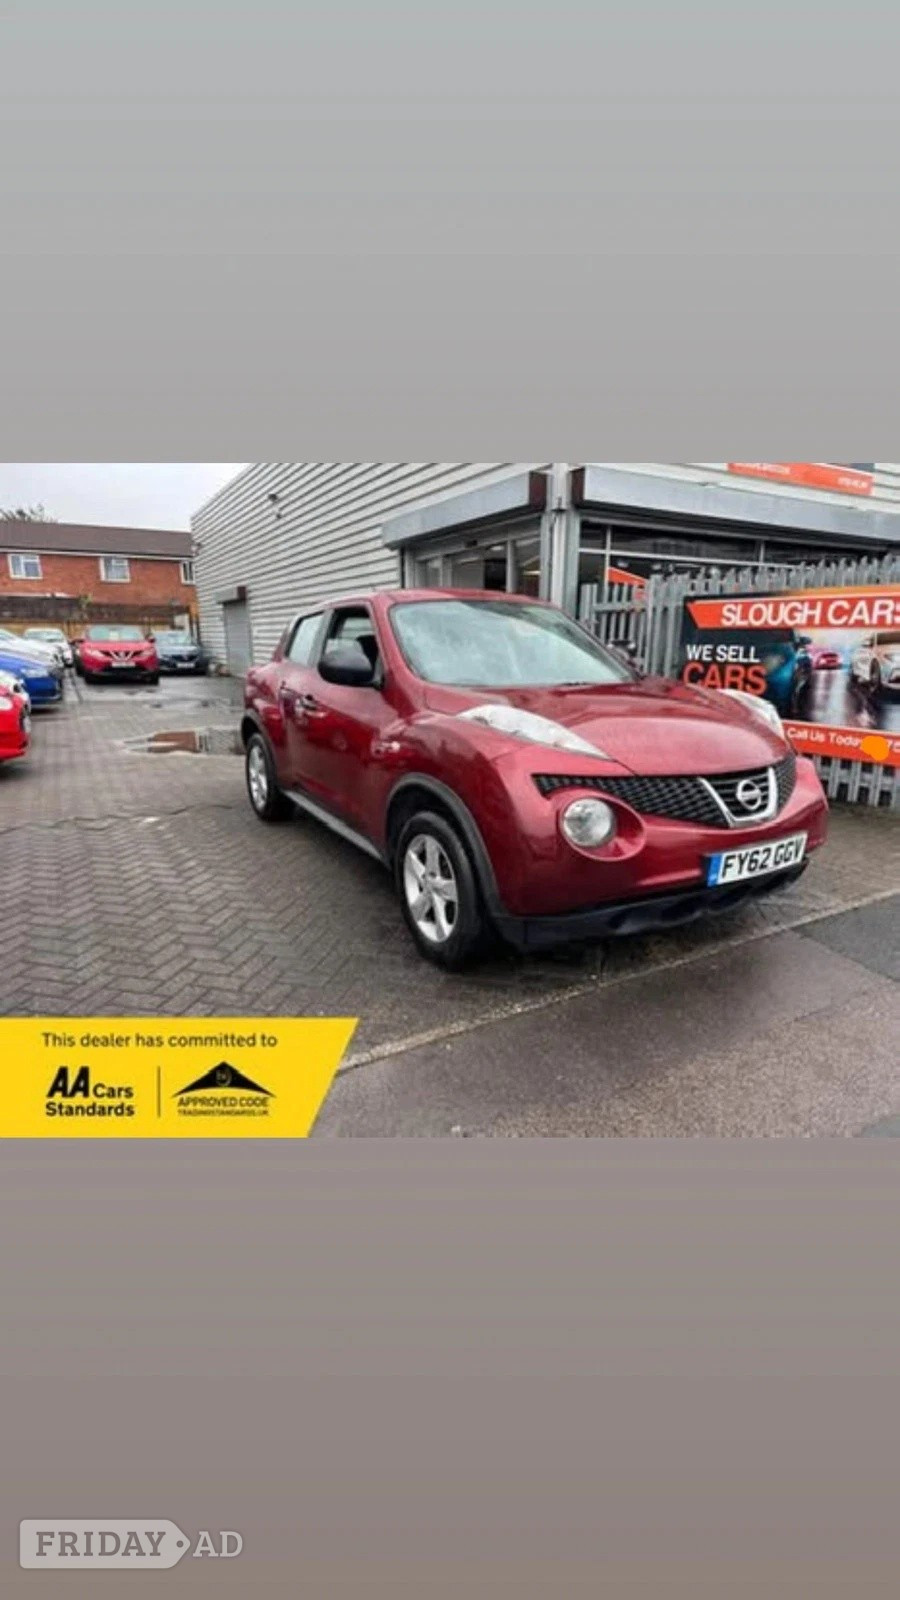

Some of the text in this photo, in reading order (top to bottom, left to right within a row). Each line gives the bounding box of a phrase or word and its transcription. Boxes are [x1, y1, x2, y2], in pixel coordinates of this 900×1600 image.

[721, 601, 821, 627] SLOUGH
[686, 645, 760, 663] WE SELL
[683, 662, 768, 696] CARS
[787, 727, 861, 748] Call Us Toda
[721, 836, 804, 879] FY62 GGV
